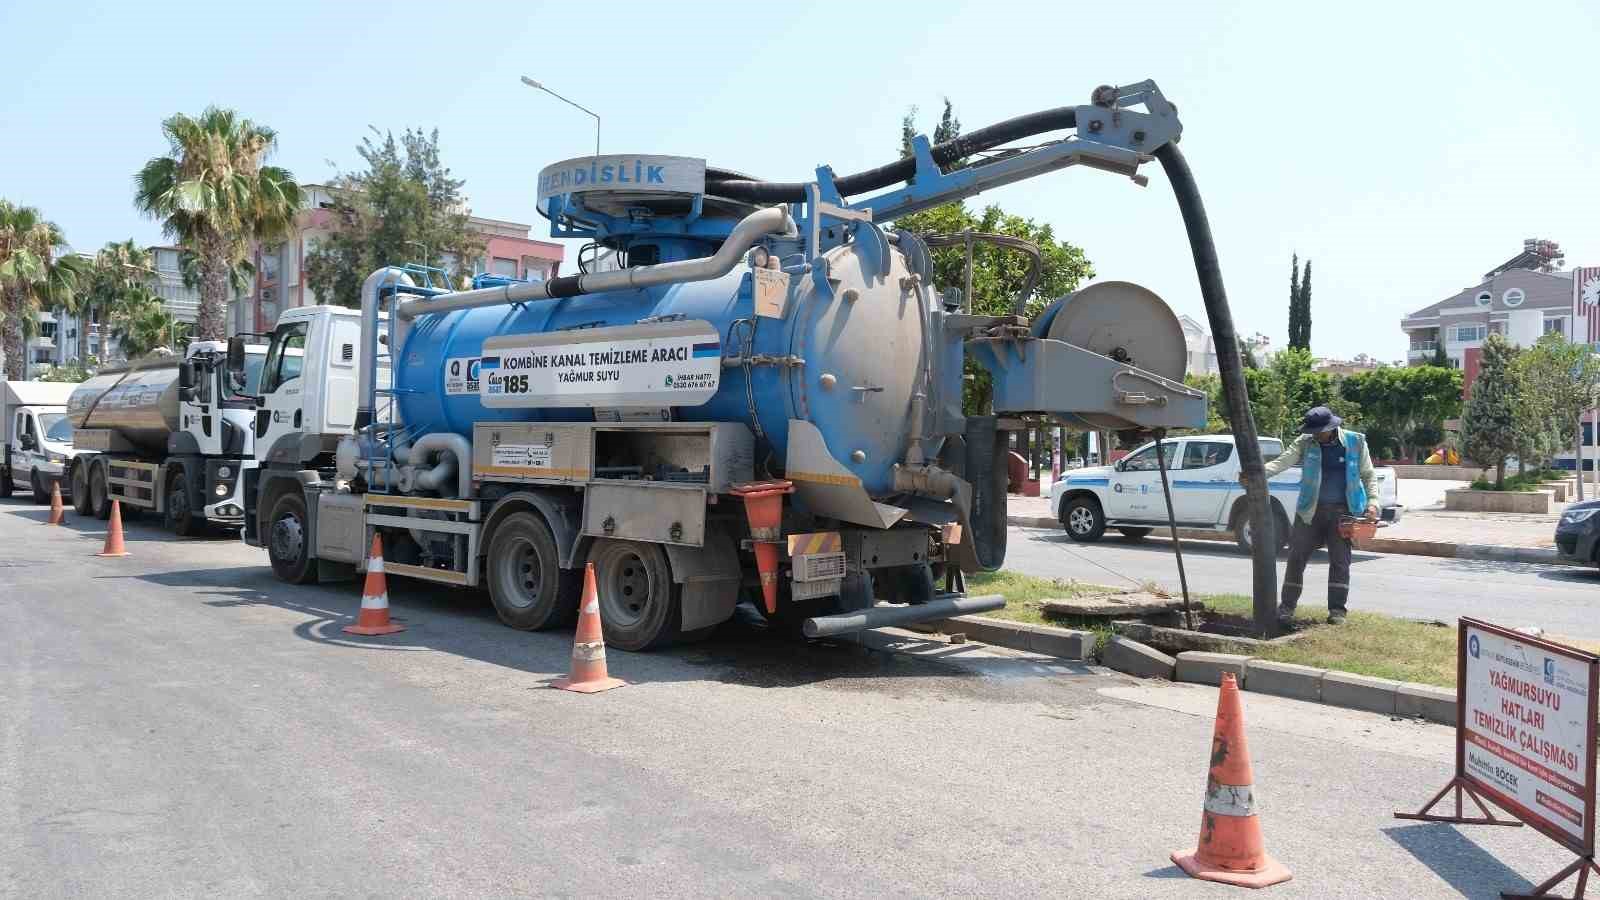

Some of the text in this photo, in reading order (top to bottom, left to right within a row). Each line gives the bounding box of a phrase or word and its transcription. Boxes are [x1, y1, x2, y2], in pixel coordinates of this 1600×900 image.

[540, 159, 665, 192] HENDİSLİK
[503, 347, 688, 369] KOMBİNE KANAL TEMİZLEME ARACI
[558, 369, 620, 383] YAĞMUR SUYU
[1489, 668, 1561, 711] YAĞMURSUYU
[1501, 697, 1545, 731] HATLARI
[1473, 709, 1517, 744] TEMİZLİK
[1519, 731, 1578, 772] ÇALIŞMASI
